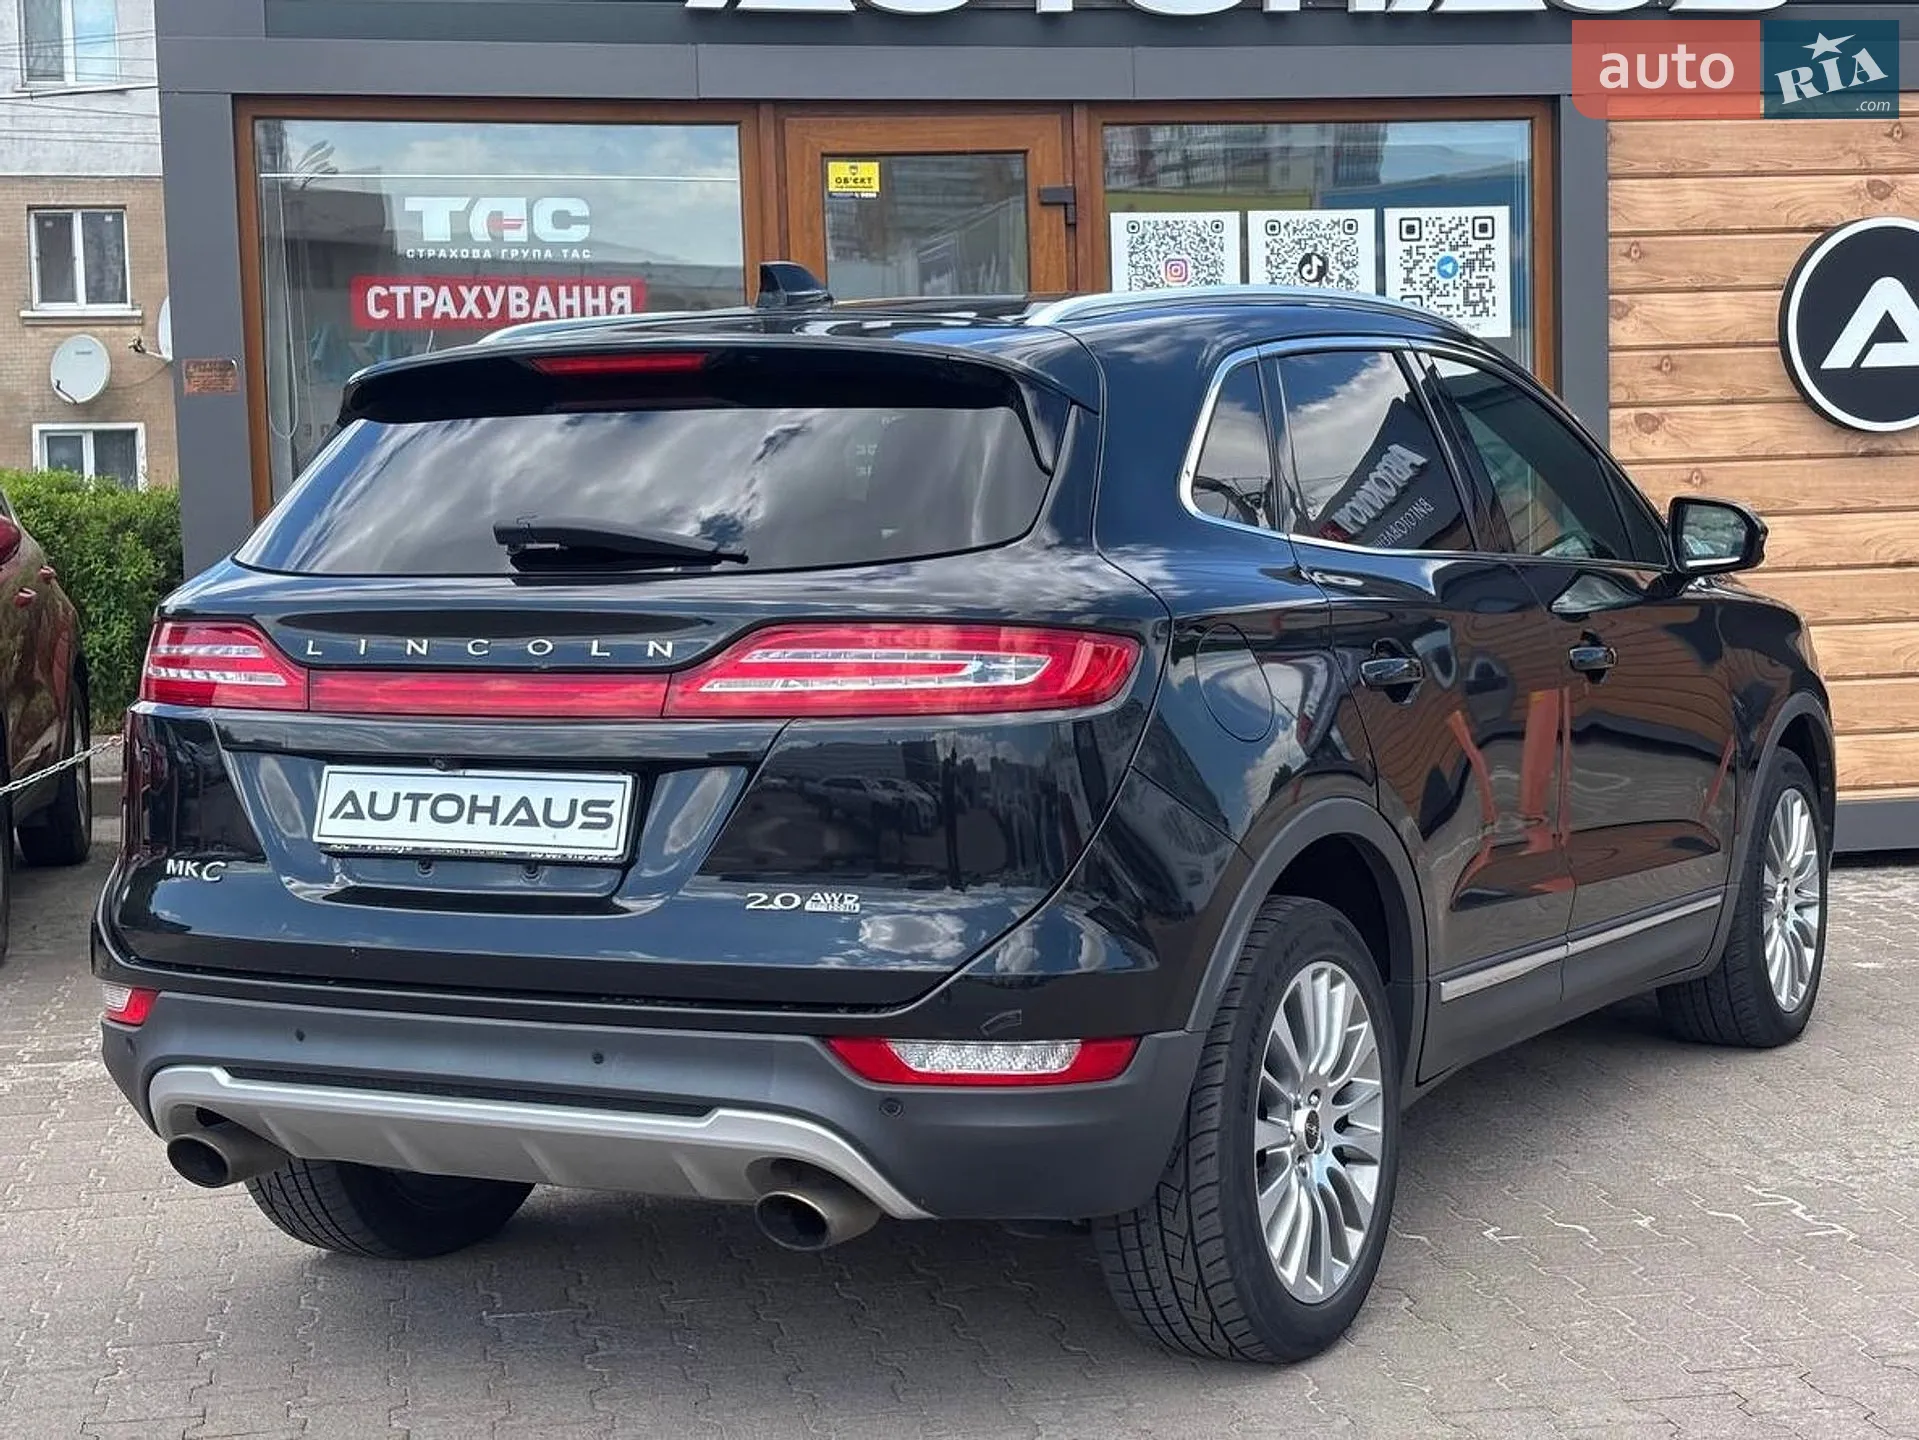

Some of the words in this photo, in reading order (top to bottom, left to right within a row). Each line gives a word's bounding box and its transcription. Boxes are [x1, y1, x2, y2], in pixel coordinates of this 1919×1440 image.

[406, 249, 492, 259] СТРАХОВА
[501, 249, 552, 259] ГРУПА
[562, 249, 592, 259] ТАС
[366, 285, 633, 319] СТРАХУВАННЯ
[306, 638, 674, 659] LINCOLN
[328, 789, 615, 831] AUTOHAUS
[745, 892, 801, 910] 2.0
